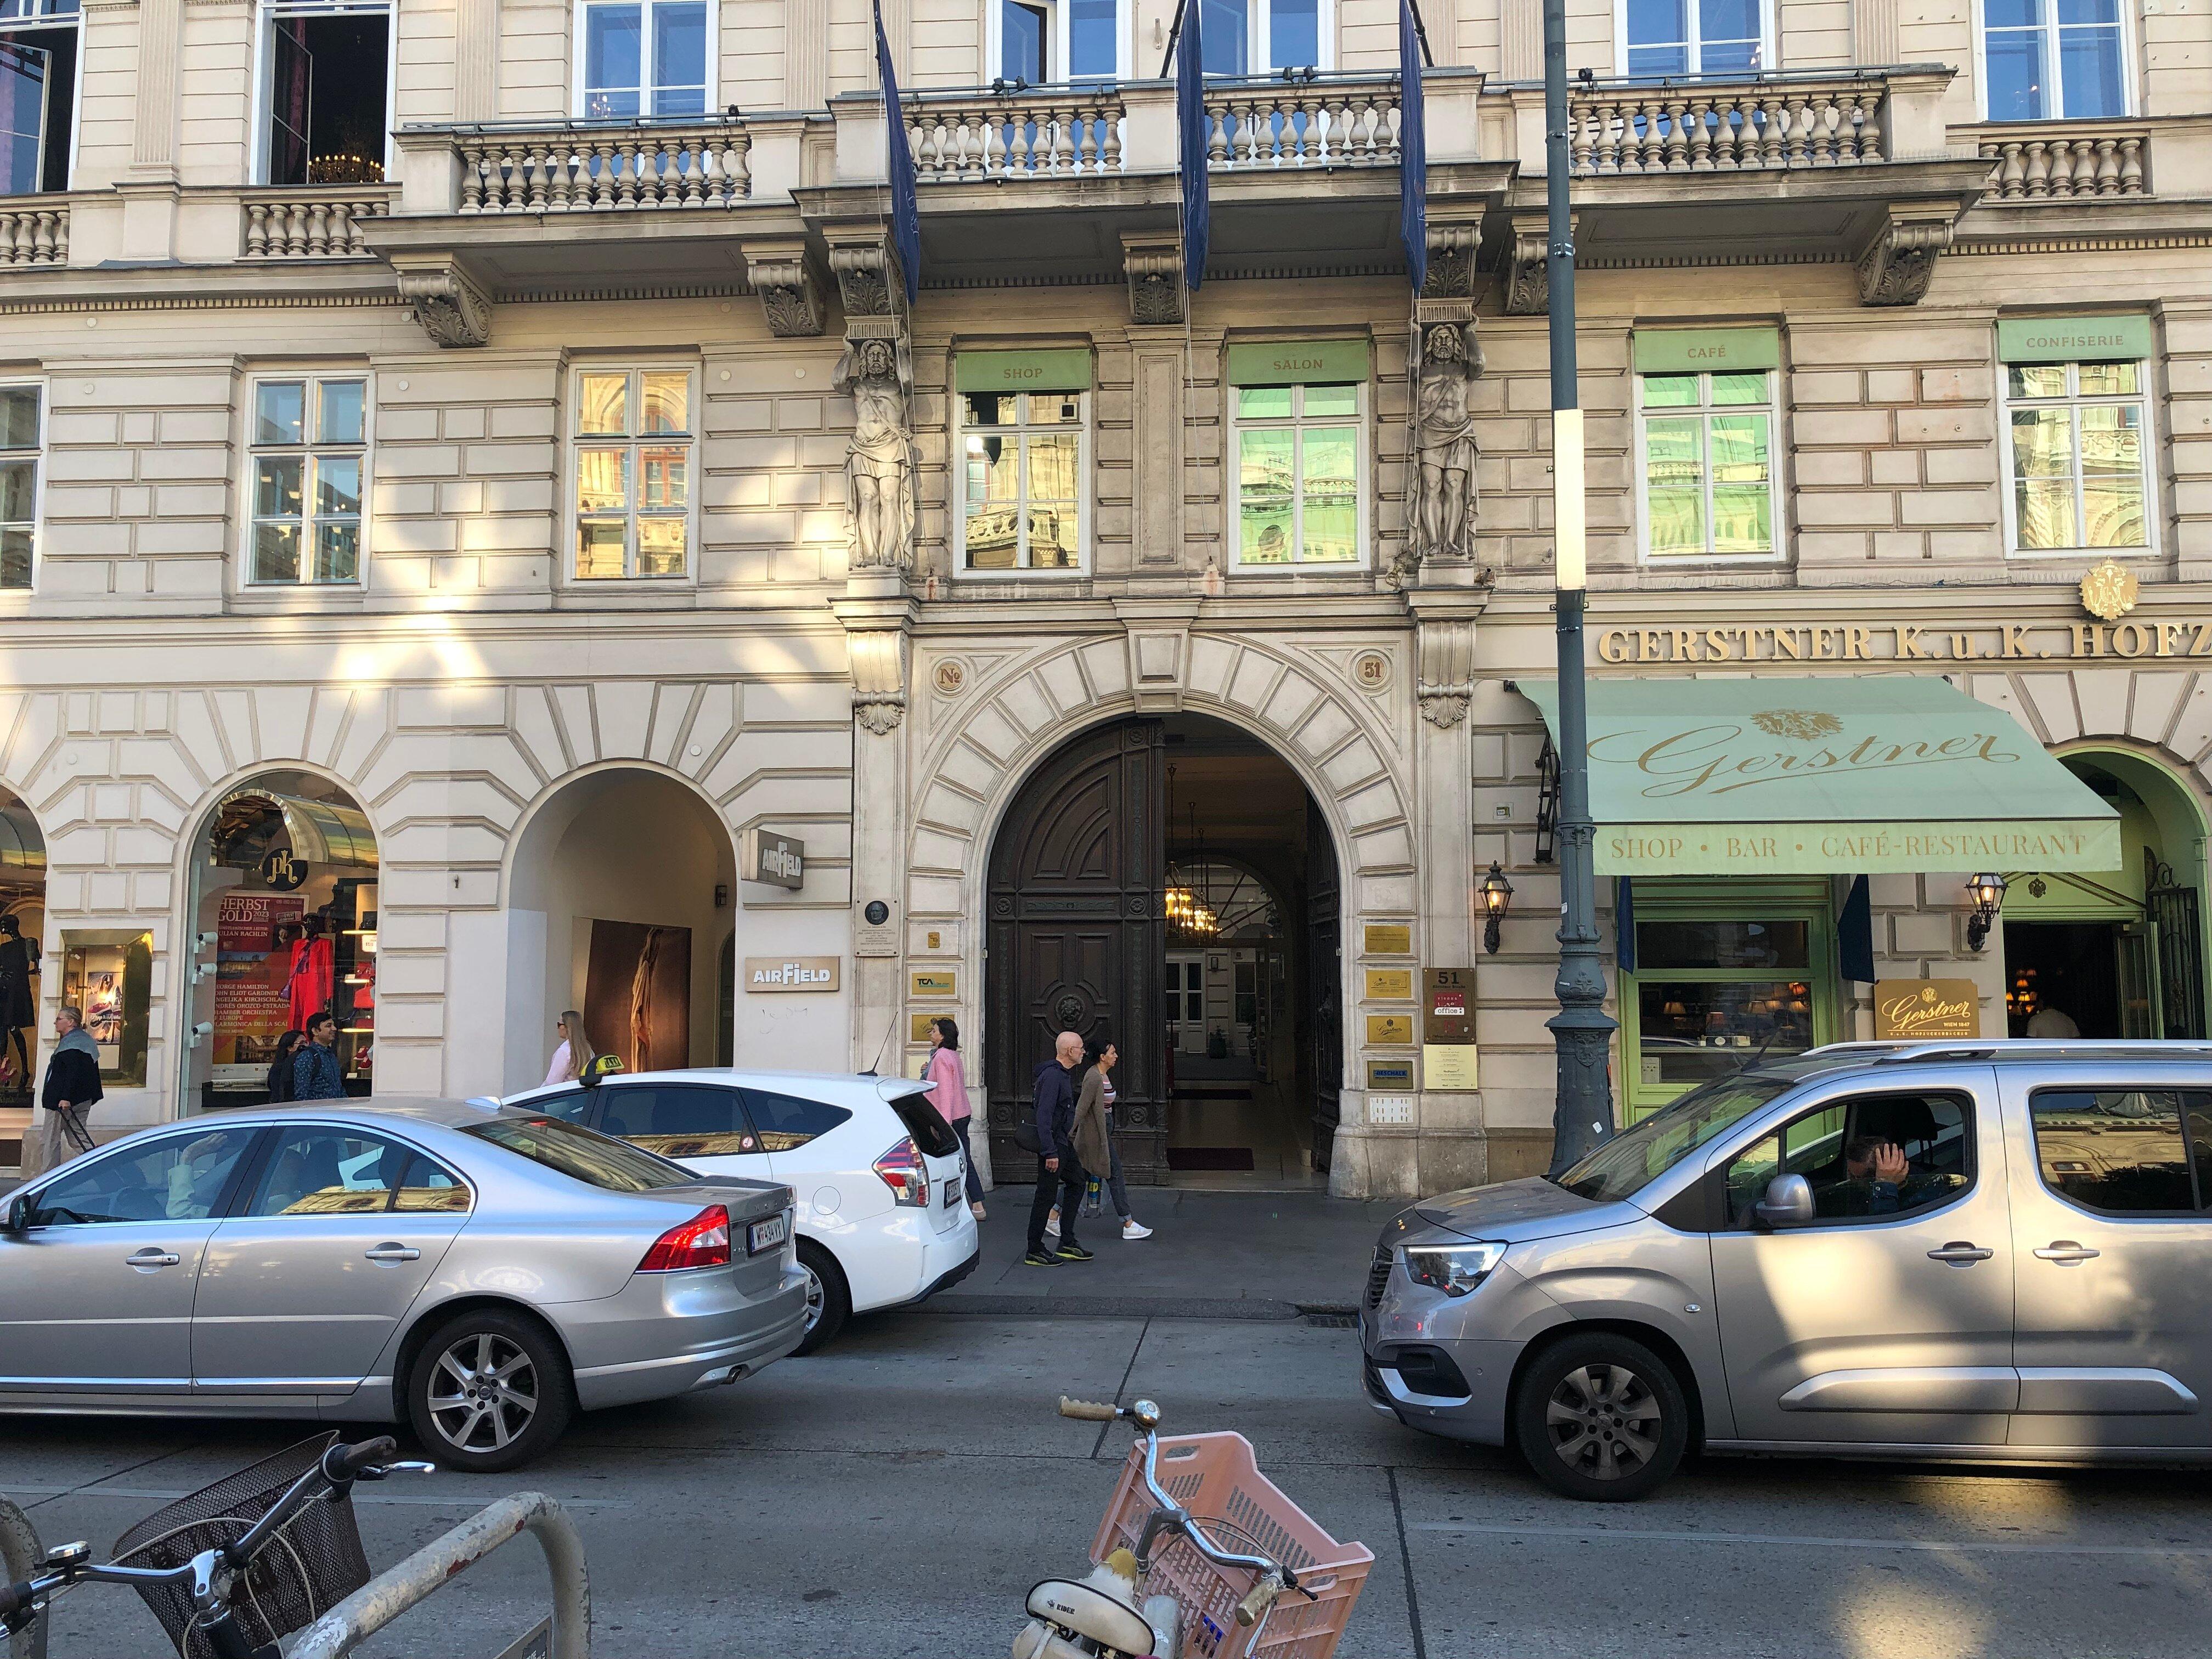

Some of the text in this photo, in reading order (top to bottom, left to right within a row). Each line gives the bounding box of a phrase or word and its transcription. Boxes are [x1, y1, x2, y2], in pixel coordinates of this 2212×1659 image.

[2026, 335, 2124, 348] CONFISERIE
[1688, 344, 1726, 358] CAFÉ
[1273, 359, 1323, 370] SALON
[1003, 368, 1043, 379] SHOP
[1598, 627, 1876, 663] GERSTNER
[1364, 662, 1381, 678] 51
[1586, 724, 2021, 798] Gerstner
[1611, 831, 2086, 859] SHOP BAR CAFÉ-RESTAURANT
[220, 898, 270, 911] HERBST
[218, 910, 253, 922] GOLD
[1438, 971, 1459, 984] 51
[1881, 994, 1971, 1029] Gerstner
[604, 1057, 622, 1069] TAXI
